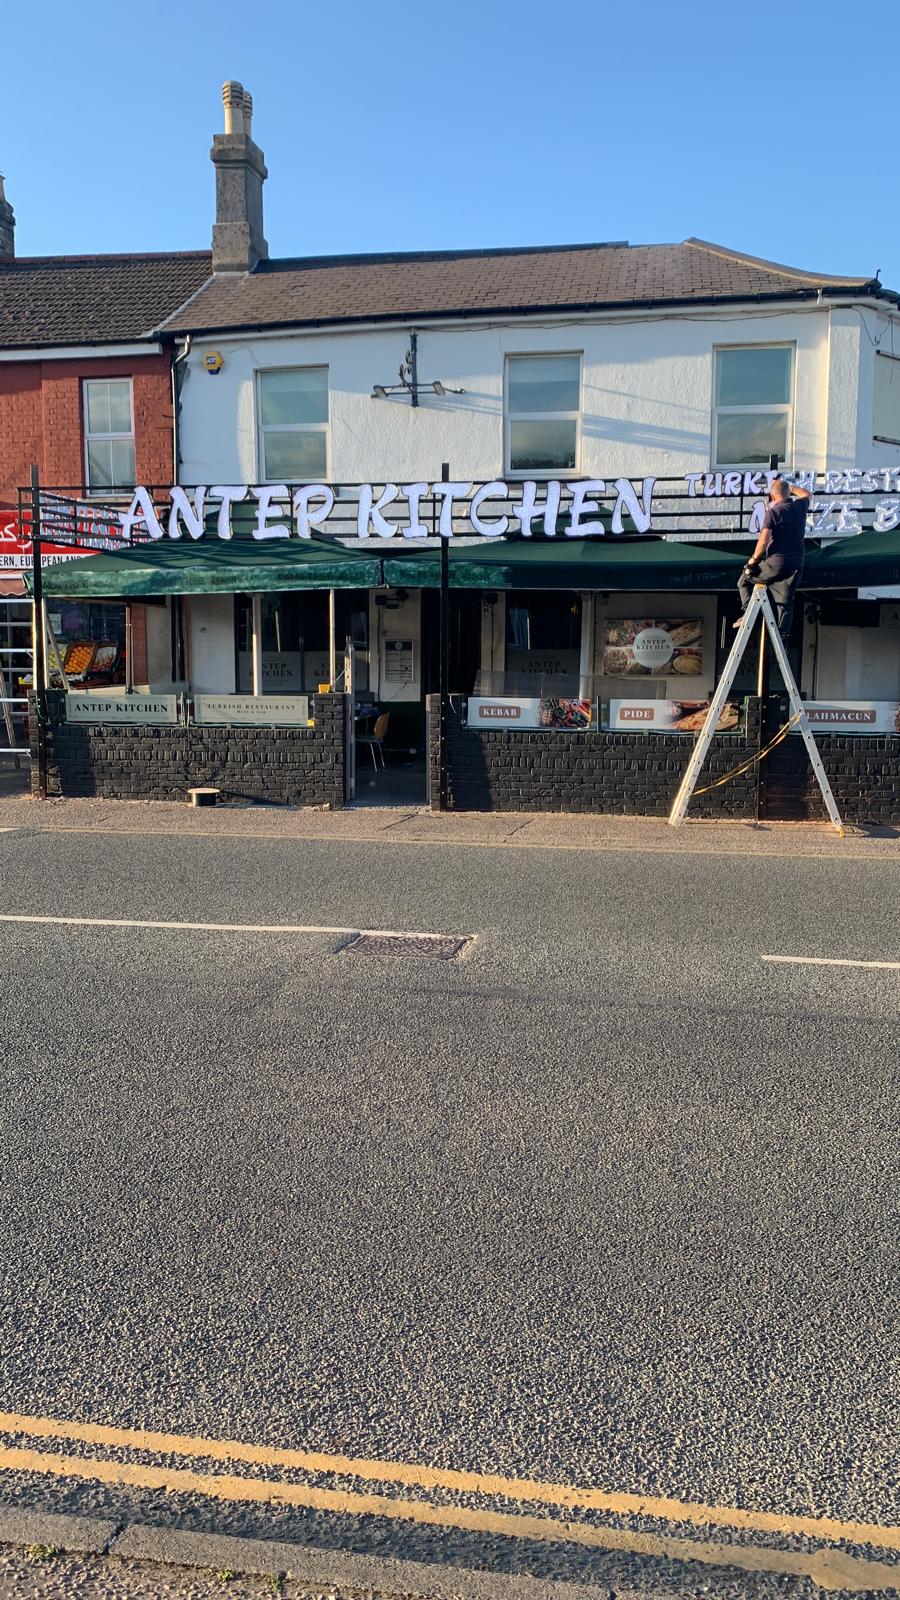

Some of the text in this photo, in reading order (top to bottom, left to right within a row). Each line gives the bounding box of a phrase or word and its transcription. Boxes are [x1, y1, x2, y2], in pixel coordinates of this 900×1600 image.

[825, 467, 900, 493] REST
[119, 485, 335, 540] ANTEP
[357, 477, 656, 538] KITCHEN
[20, 555, 63, 566] EUPEAN
[75, 704, 169, 713] ANTEP KITCHEN
[482, 708, 518, 717] KEBAB
[623, 710, 651, 719] PIDE
[807, 712, 872, 721] LAHMACUN
